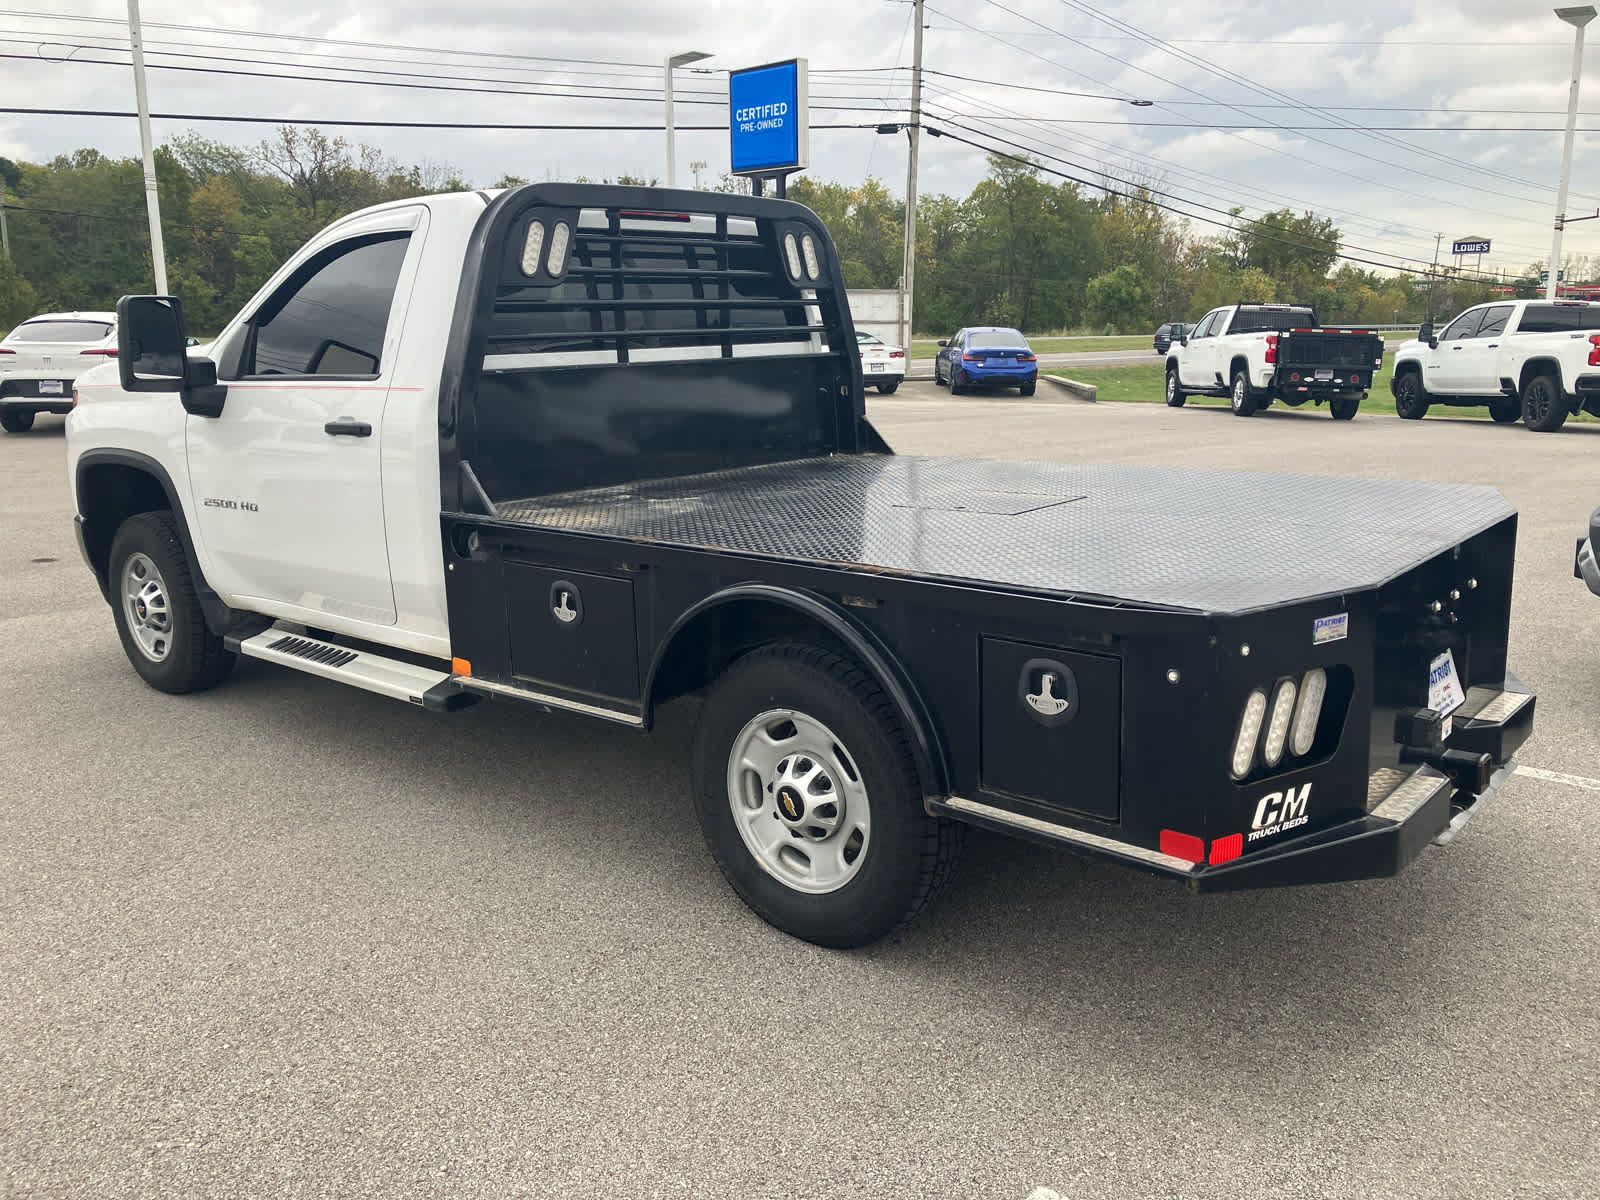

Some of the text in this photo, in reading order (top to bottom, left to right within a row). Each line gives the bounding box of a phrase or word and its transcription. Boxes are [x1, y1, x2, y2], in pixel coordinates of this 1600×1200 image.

[736, 102, 787, 121] CERTIFIED
[740, 118, 783, 132] PRE-OWNED
[1454, 242, 1488, 252] LOWE'S
[203, 498, 237, 510] 2500
[1430, 659, 1451, 686] ATRIOT
[1251, 782, 1312, 830] CM
[1248, 815, 1309, 842] TRUCK BEDS
